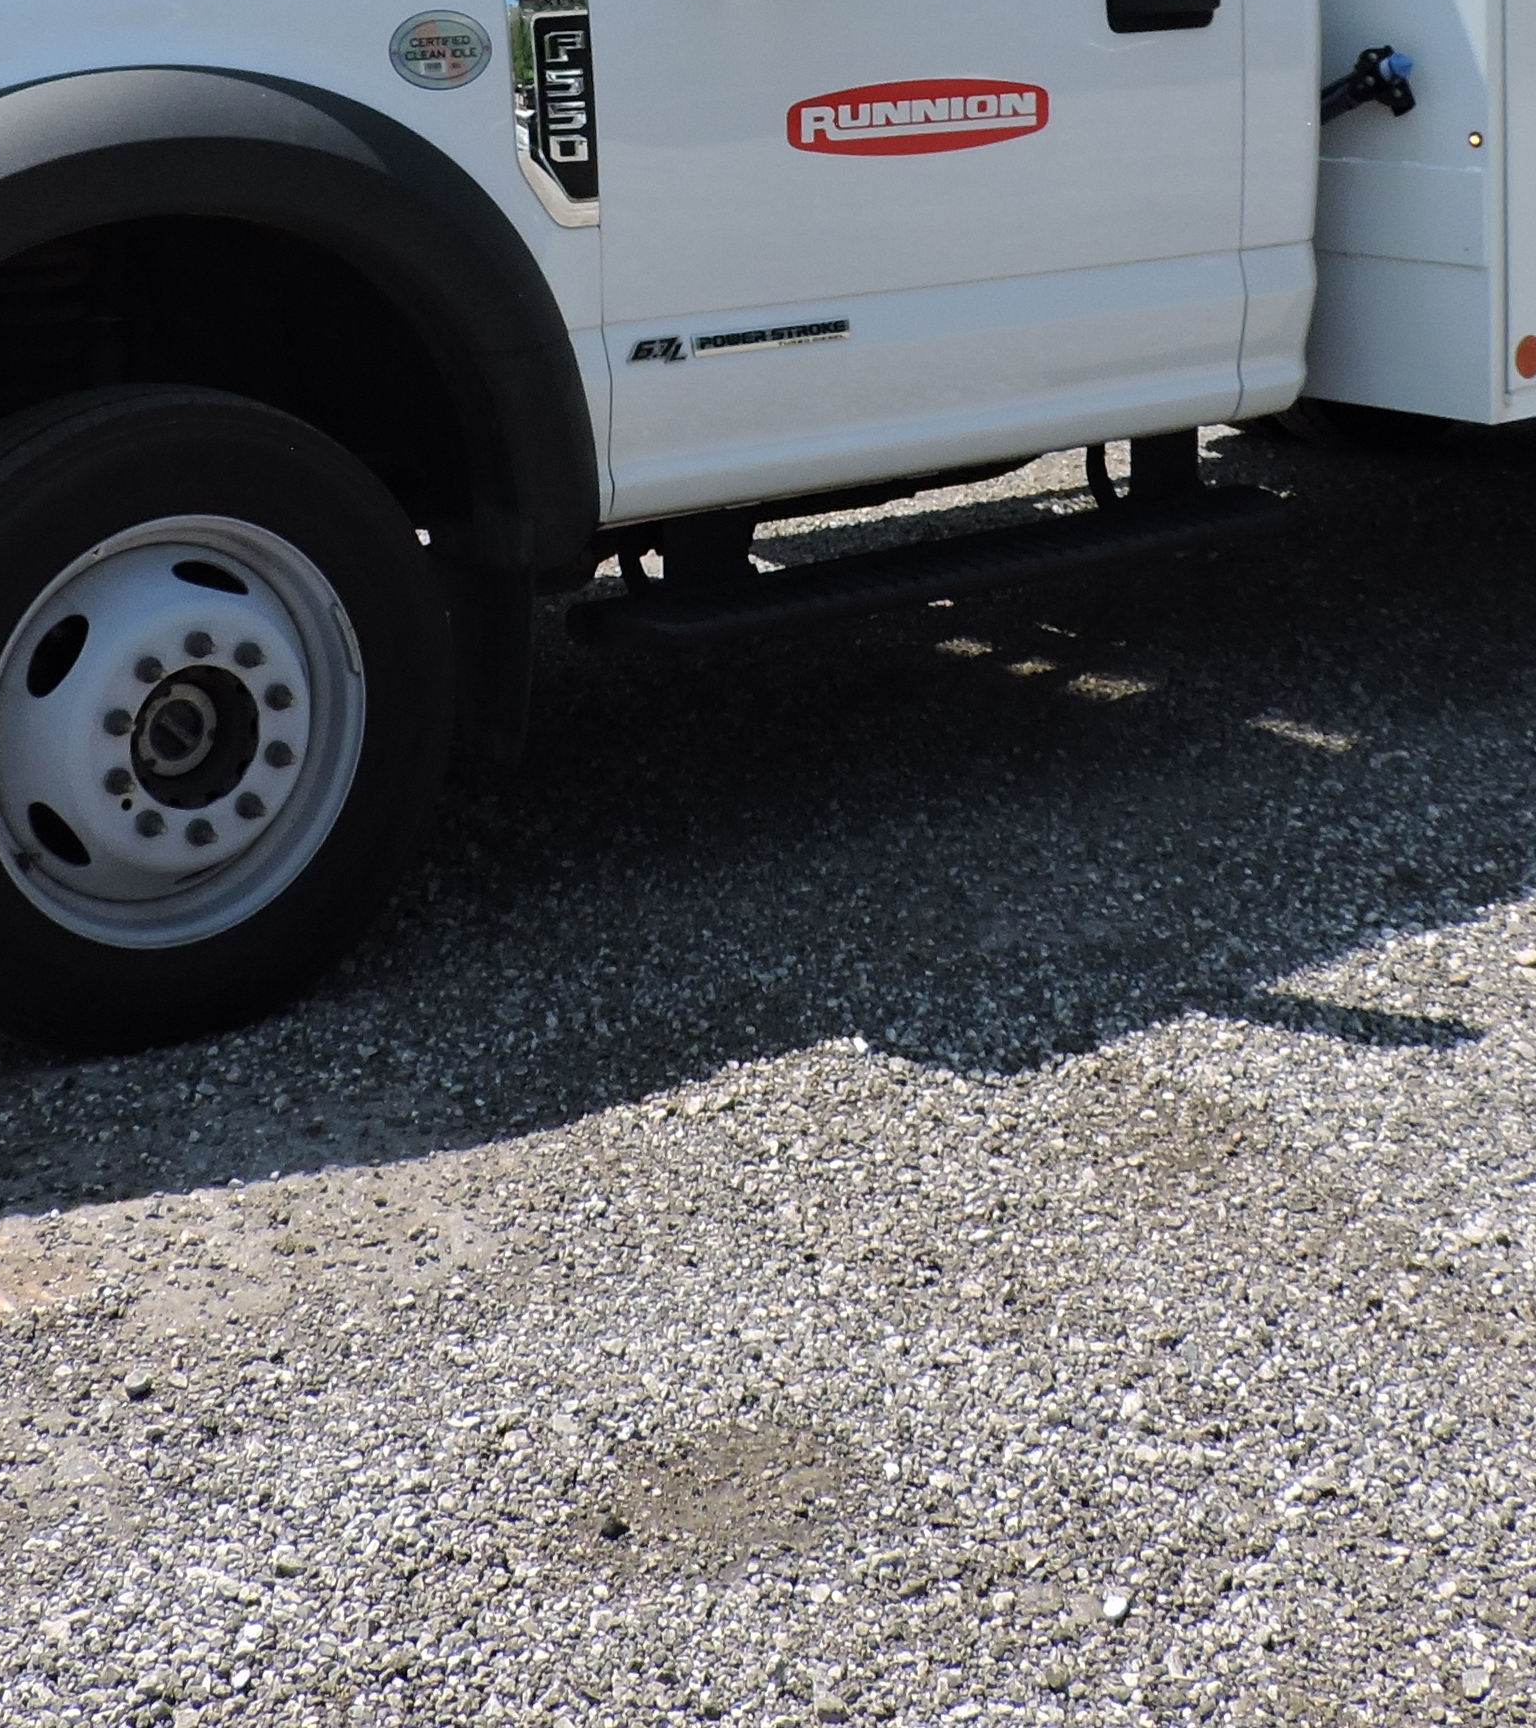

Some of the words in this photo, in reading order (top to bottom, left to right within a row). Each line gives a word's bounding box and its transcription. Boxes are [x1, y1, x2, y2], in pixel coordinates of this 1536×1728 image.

[404, 49, 446, 62] CLEAN
[451, 47, 478, 59] IDLE
[409, 35, 470, 48] CERTIFIED
[544, 30, 589, 163] F550
[800, 91, 1037, 143] RUNNION
[630, 335, 688, 363] 6.7L
[698, 330, 767, 351] POWER
[770, 319, 849, 342] STROKE
